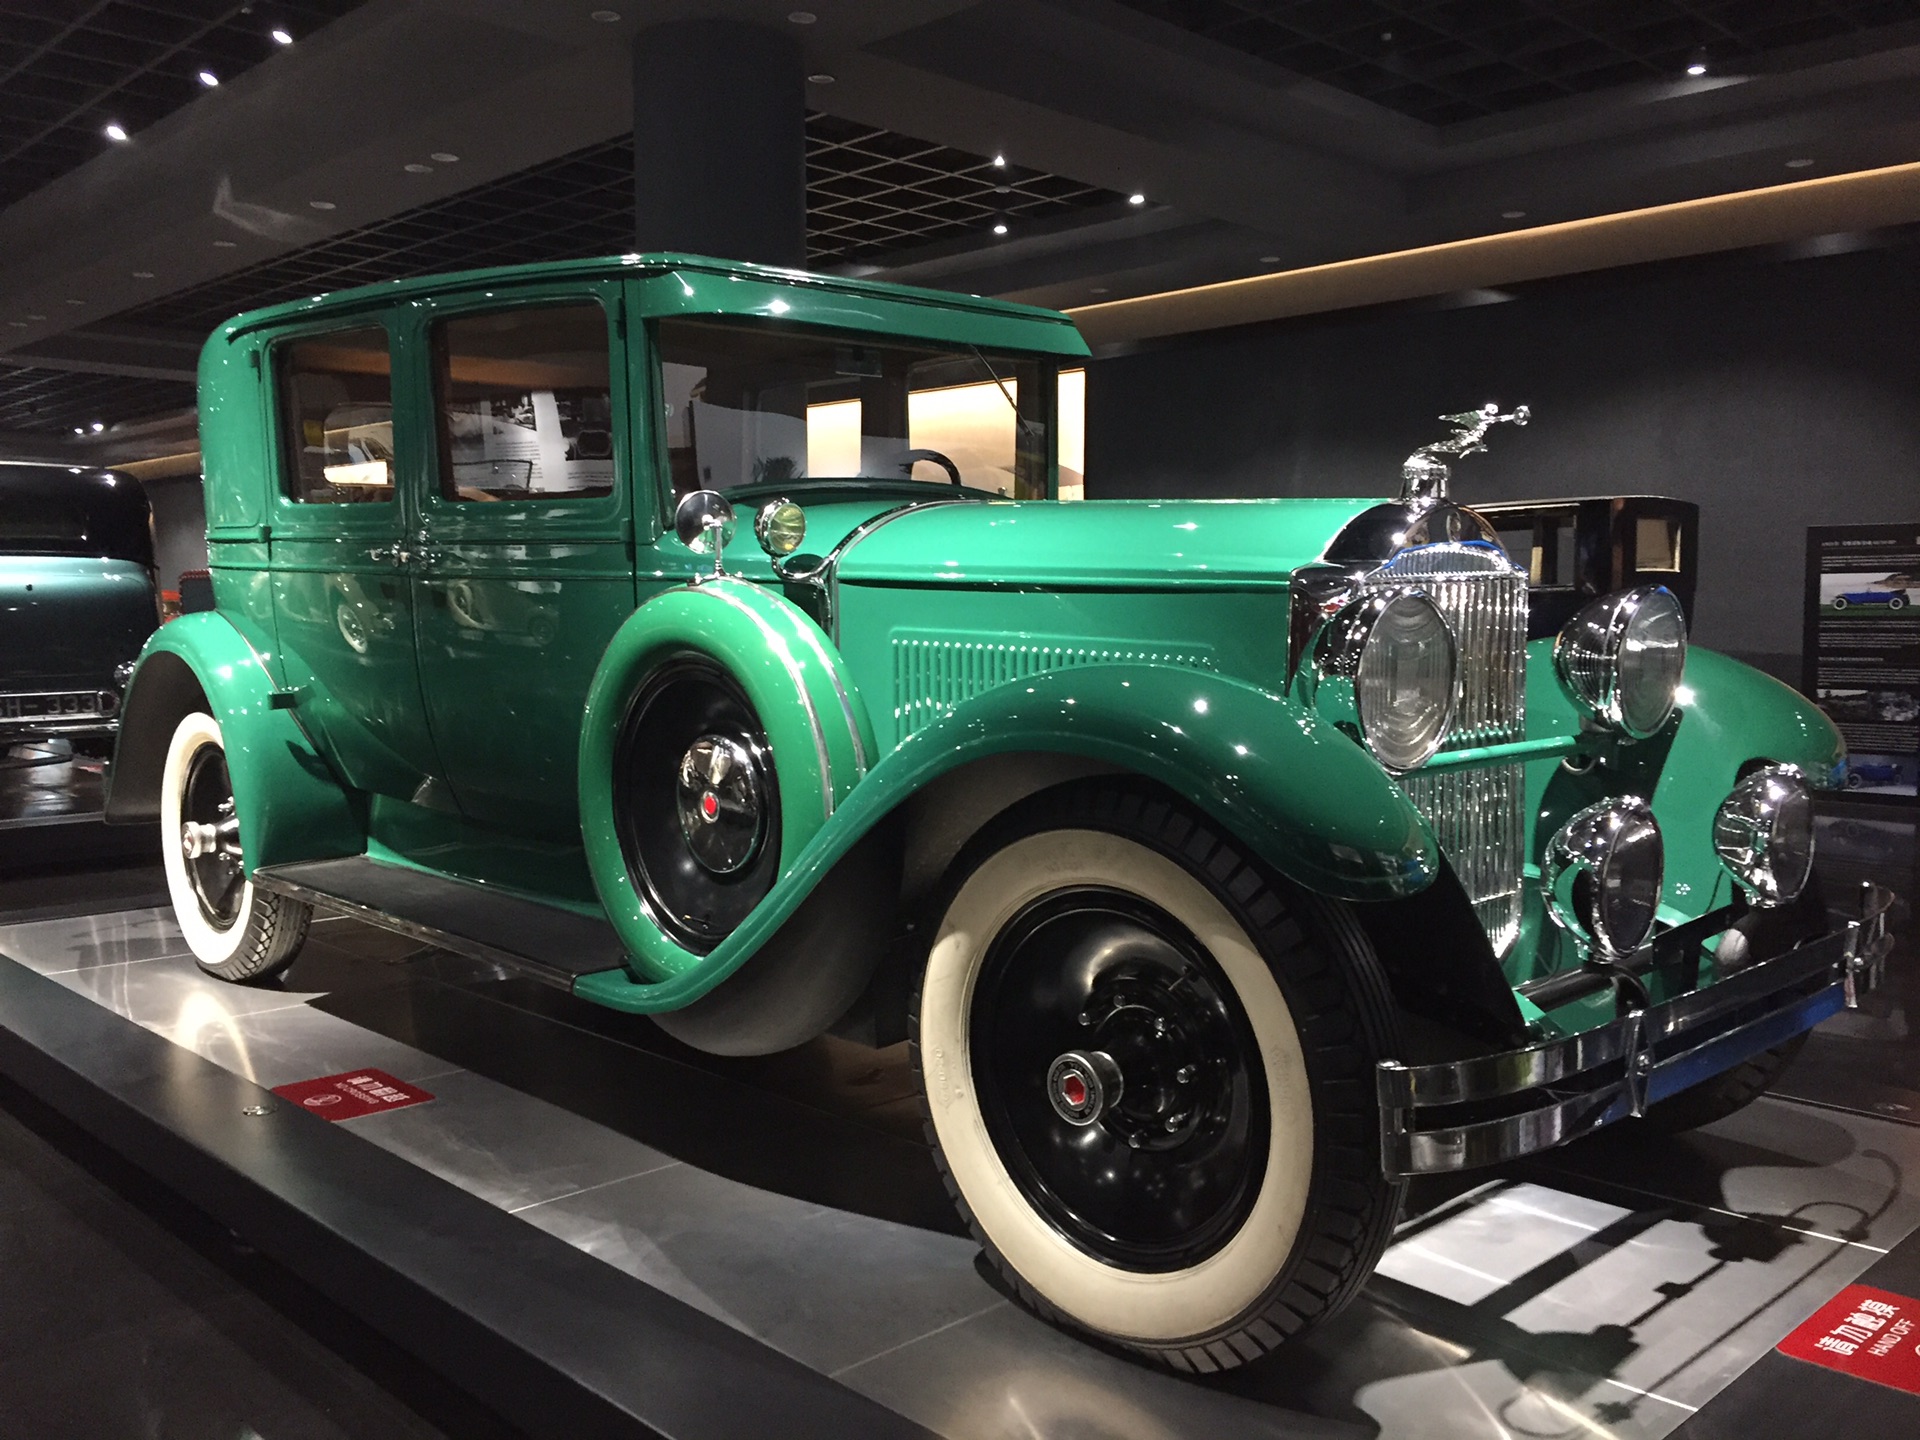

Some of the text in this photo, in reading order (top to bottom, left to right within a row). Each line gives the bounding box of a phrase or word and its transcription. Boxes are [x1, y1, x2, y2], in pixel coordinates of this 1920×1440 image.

[1814, 1299, 1900, 1356] 请勿触摸
[1867, 1318, 1915, 1357] HAND OFF
